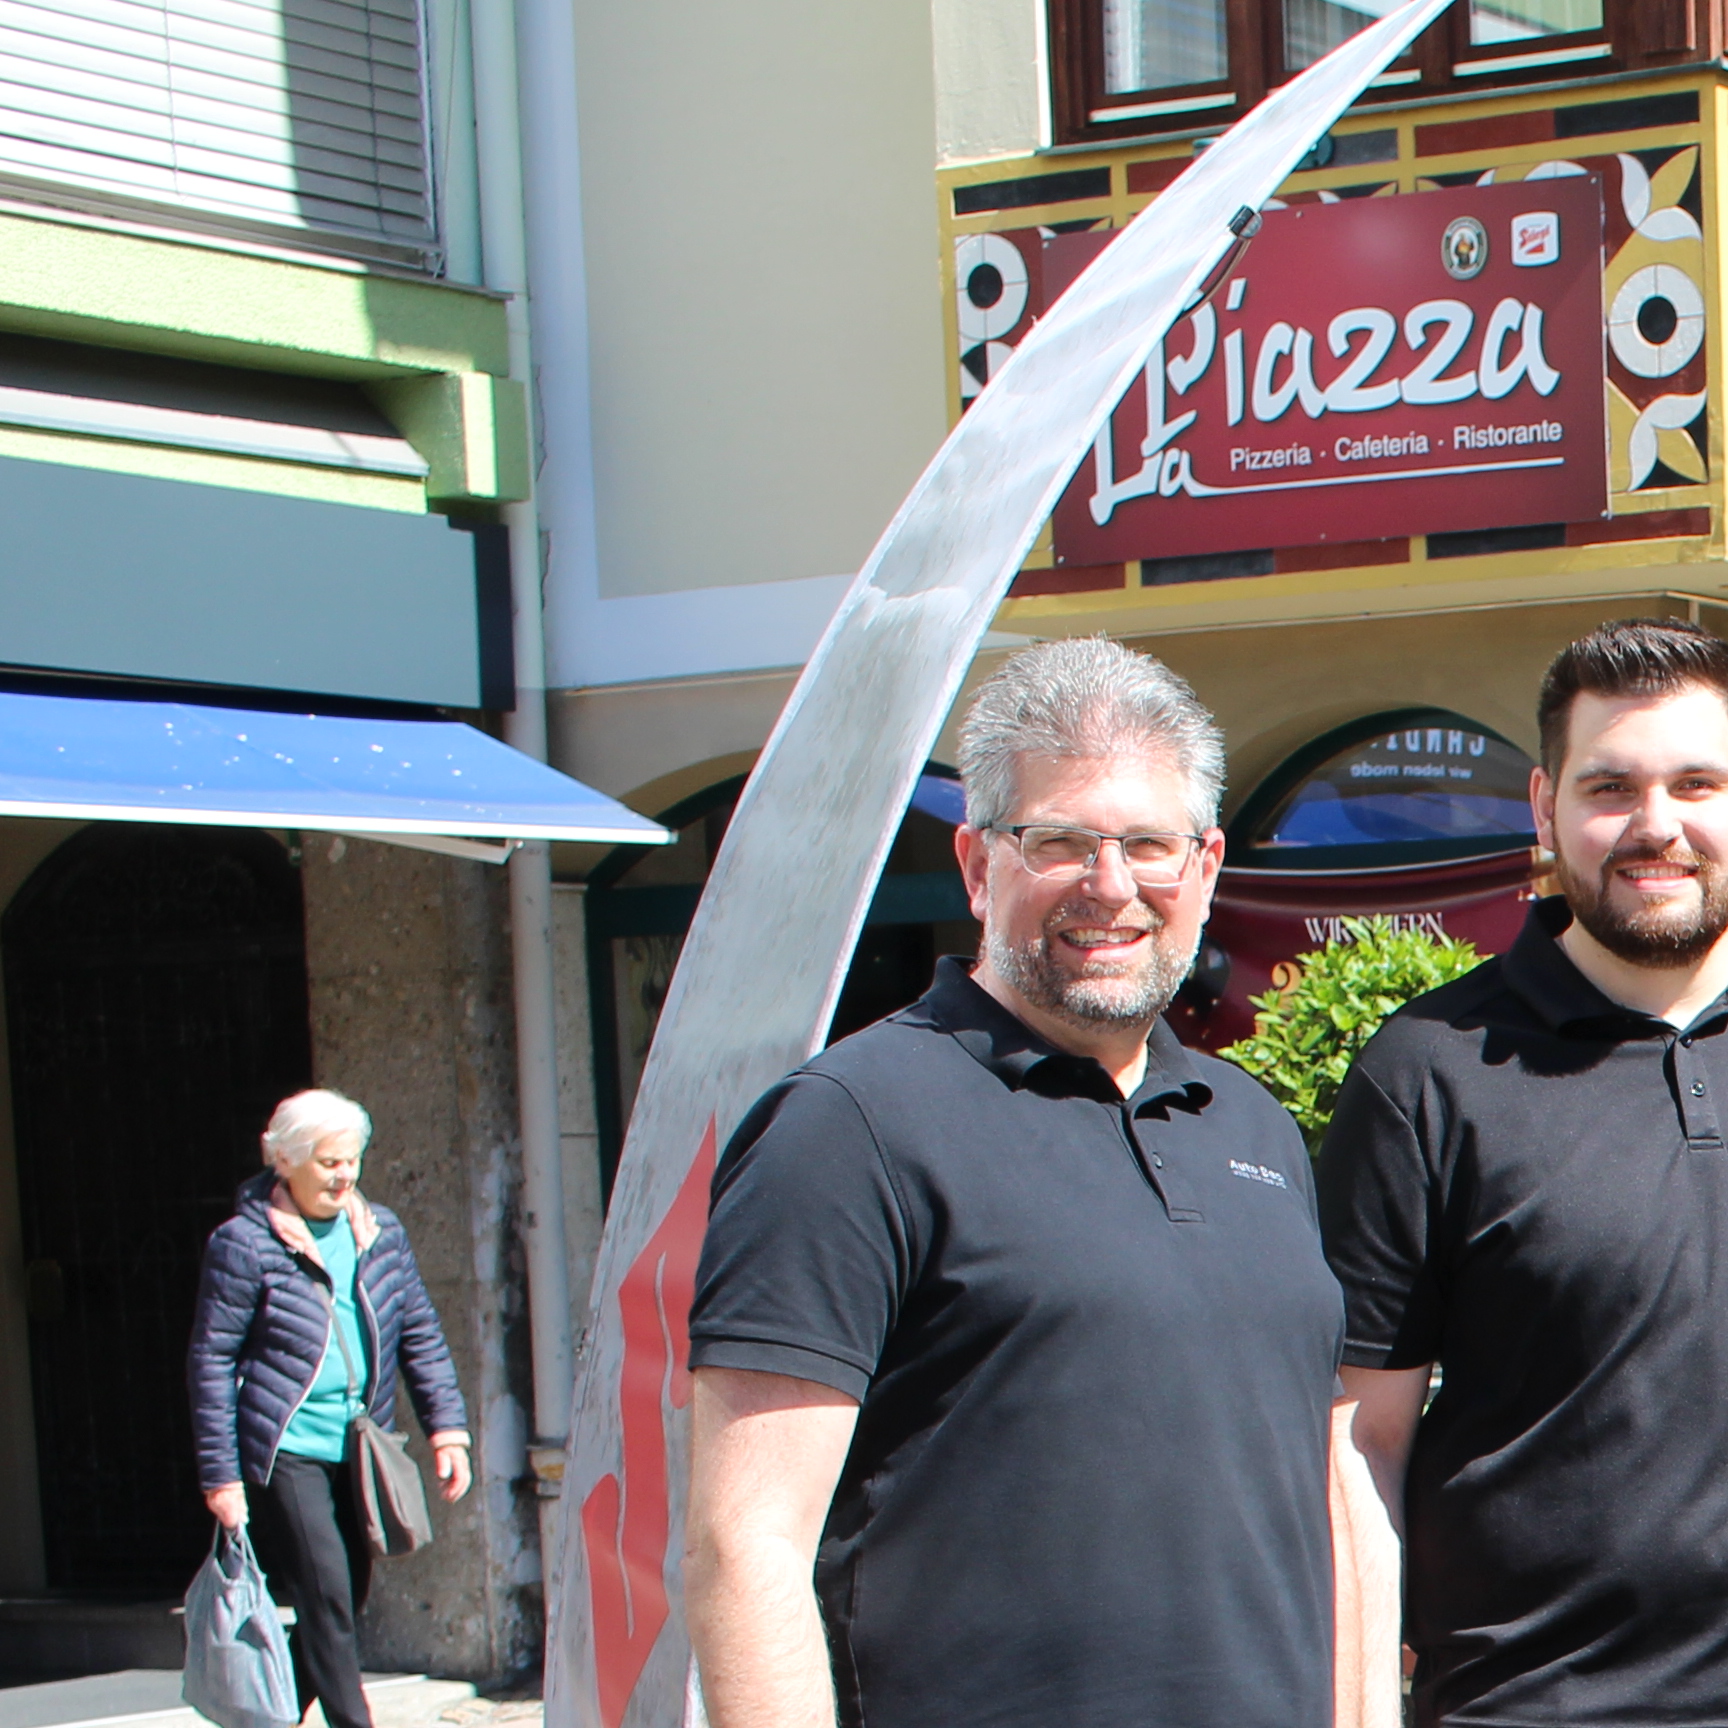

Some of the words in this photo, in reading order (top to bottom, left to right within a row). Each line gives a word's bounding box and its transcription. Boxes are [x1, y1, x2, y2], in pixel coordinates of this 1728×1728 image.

[1141, 278, 1562, 458] Piazza
[1230, 438, 1312, 472] Pizzeria
[1334, 428, 1430, 462] Cafeteria
[1452, 418, 1563, 452] Ristorante
[1229, 1159, 1259, 1175] Auto
